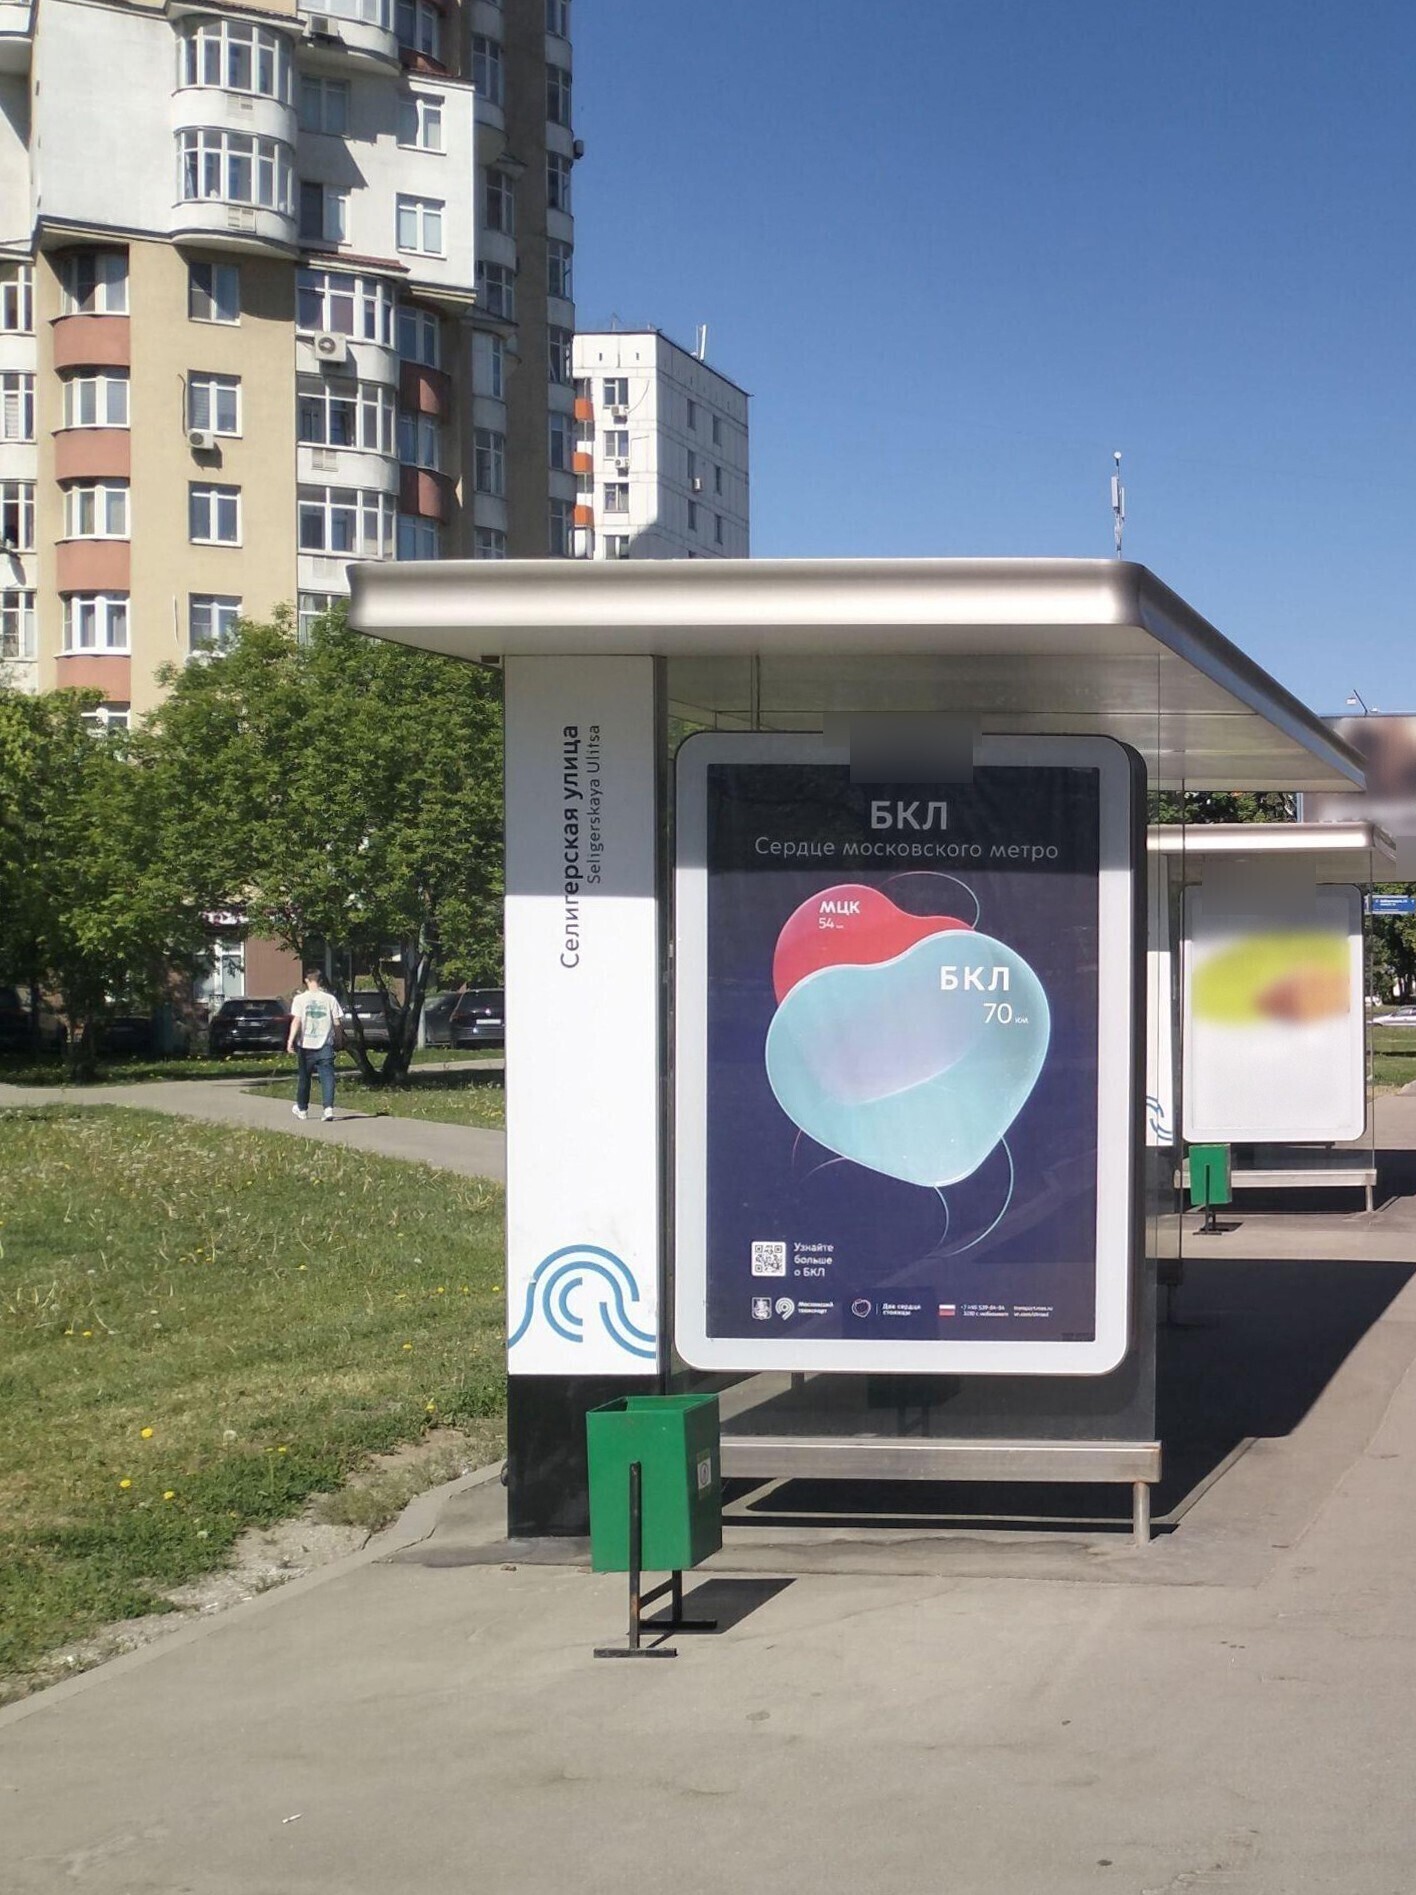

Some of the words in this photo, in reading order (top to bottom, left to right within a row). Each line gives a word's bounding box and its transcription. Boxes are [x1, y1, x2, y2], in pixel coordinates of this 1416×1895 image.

[586, 725, 601, 773] Ulitsa
[562, 725, 584, 801] улица
[870, 801, 948, 831] БКЛ
[587, 779, 604, 884] Seligerskaya
[755, 837, 835, 859] Сердце
[843, 841, 982, 859] московского
[990, 844, 1059, 862] метро
[560, 808, 584, 969] Селигерская
[818, 900, 860, 916] МЦК
[818, 917, 834, 929] 54
[939, 965, 1010, 991] БКЛ
[983, 1002, 1012, 1024] 70
[793, 1242, 834, 1253] Узнайте
[793, 1254, 833, 1265] больше
[793, 1269, 801, 1277] о
[803, 1267, 826, 1277] БКЛ
